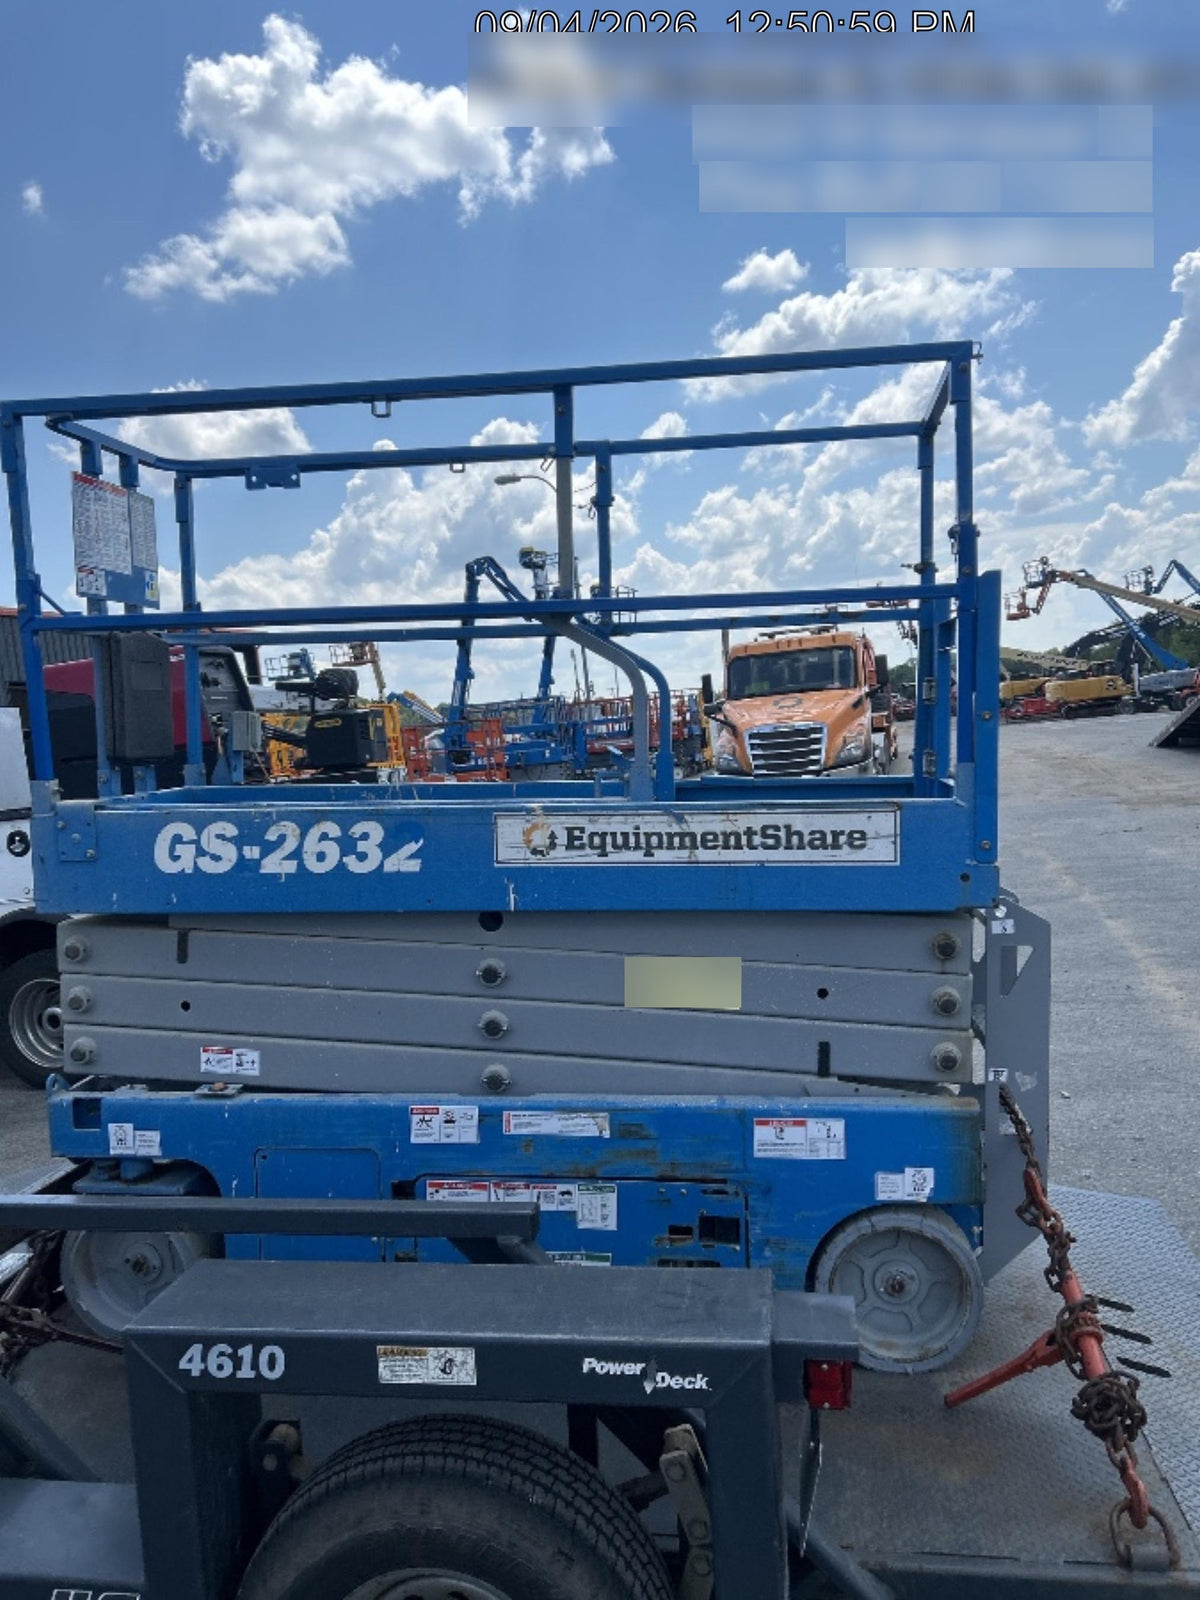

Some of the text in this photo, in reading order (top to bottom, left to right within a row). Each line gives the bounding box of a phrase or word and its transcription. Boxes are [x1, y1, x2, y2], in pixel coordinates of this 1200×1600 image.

[154, 820, 424, 874] GS-2632
[564, 824, 867, 857] EquipmentShare
[178, 1343, 286, 1380] 4610
[582, 1357, 646, 1375] Power
